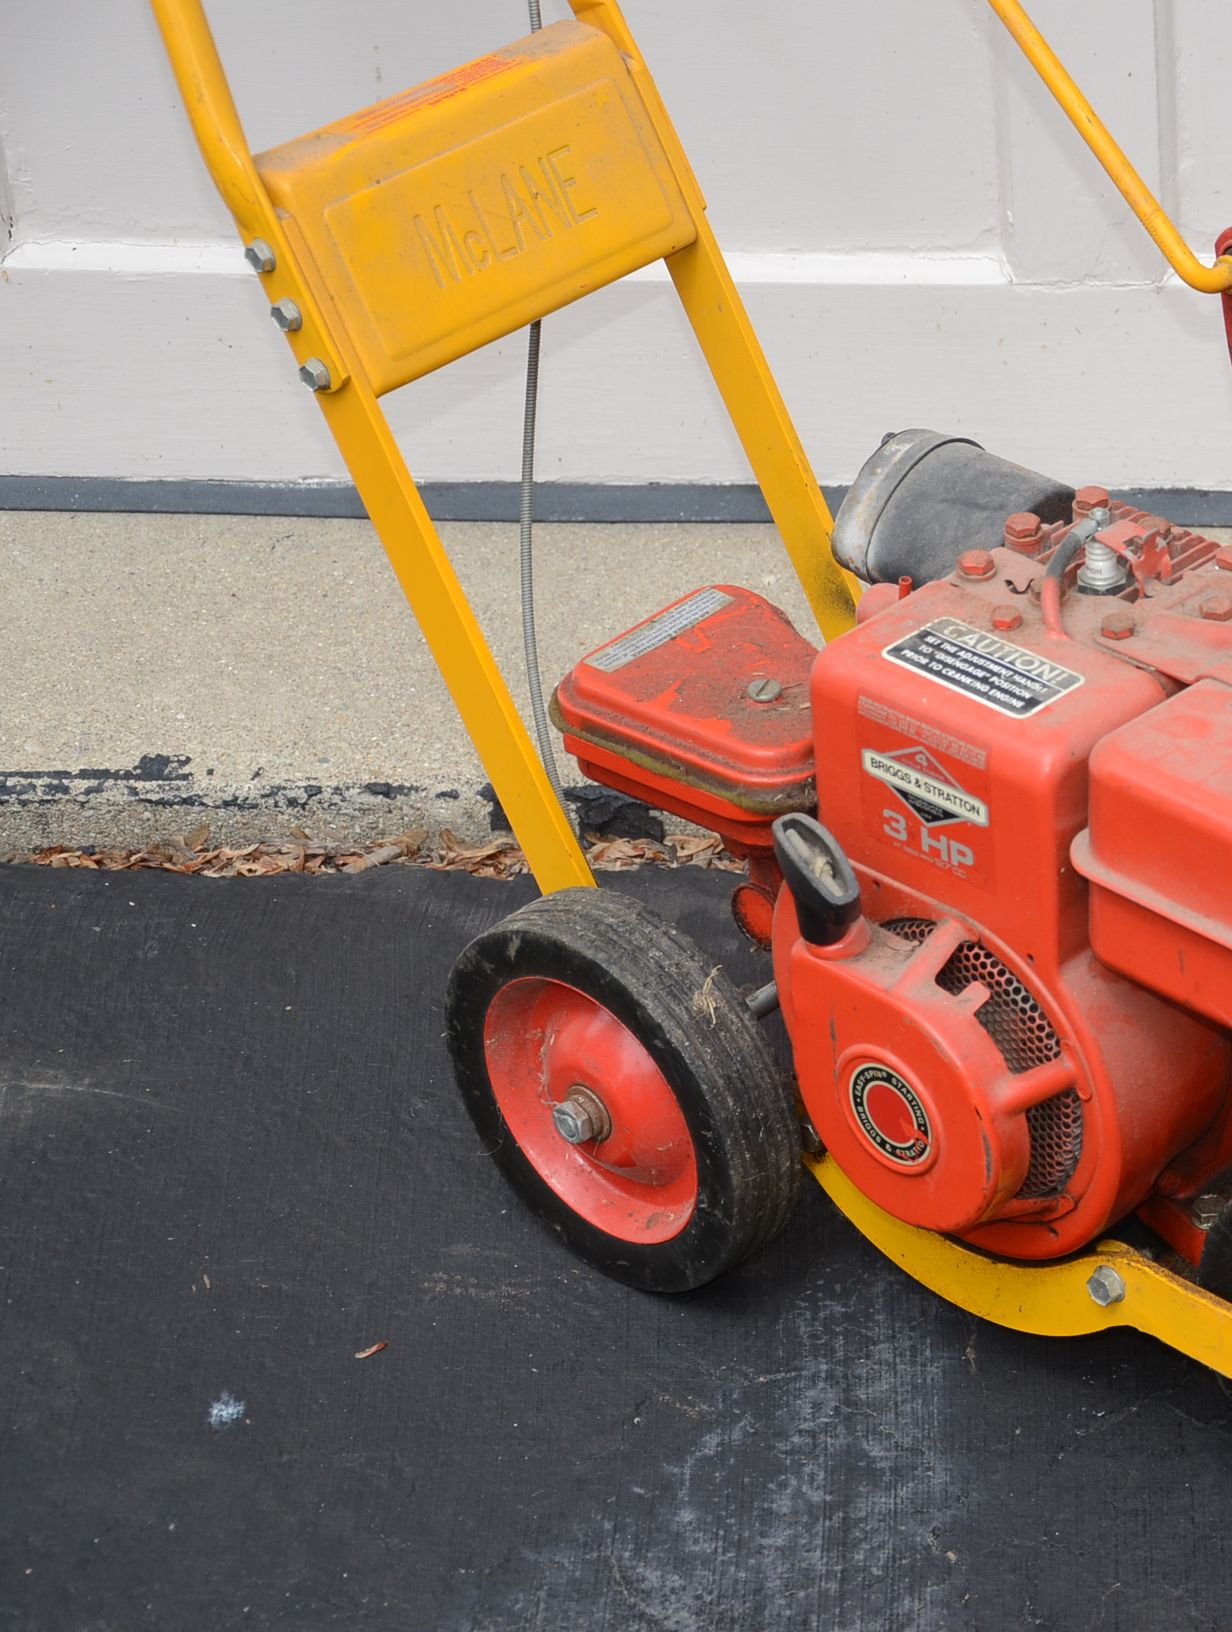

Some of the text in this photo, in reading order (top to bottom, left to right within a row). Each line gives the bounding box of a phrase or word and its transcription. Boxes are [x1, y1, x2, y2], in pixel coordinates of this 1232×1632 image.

[412, 144, 600, 289] McLANE
[900, 648, 1026, 709] PRIOR TO CRANKING ENGINE
[918, 644, 932, 654] TO
[988, 675, 1032, 700] POSITION
[924, 635, 940, 645] SET
[940, 641, 957, 653] THE
[957, 648, 1013, 678] ADJUSTMENT
[943, 625, 1069, 685] CAUTION!
[870, 757, 912, 784] BRIGGS
[914, 777, 922, 789] &
[924, 782, 981, 816] STRATTON
[882, 809, 907, 841] 3
[920, 827, 974, 866] HP
[857, 1106, 882, 1143] BRIGGS
[885, 1144, 892, 1152] &
[891, 1078, 925, 1125] STARTING
